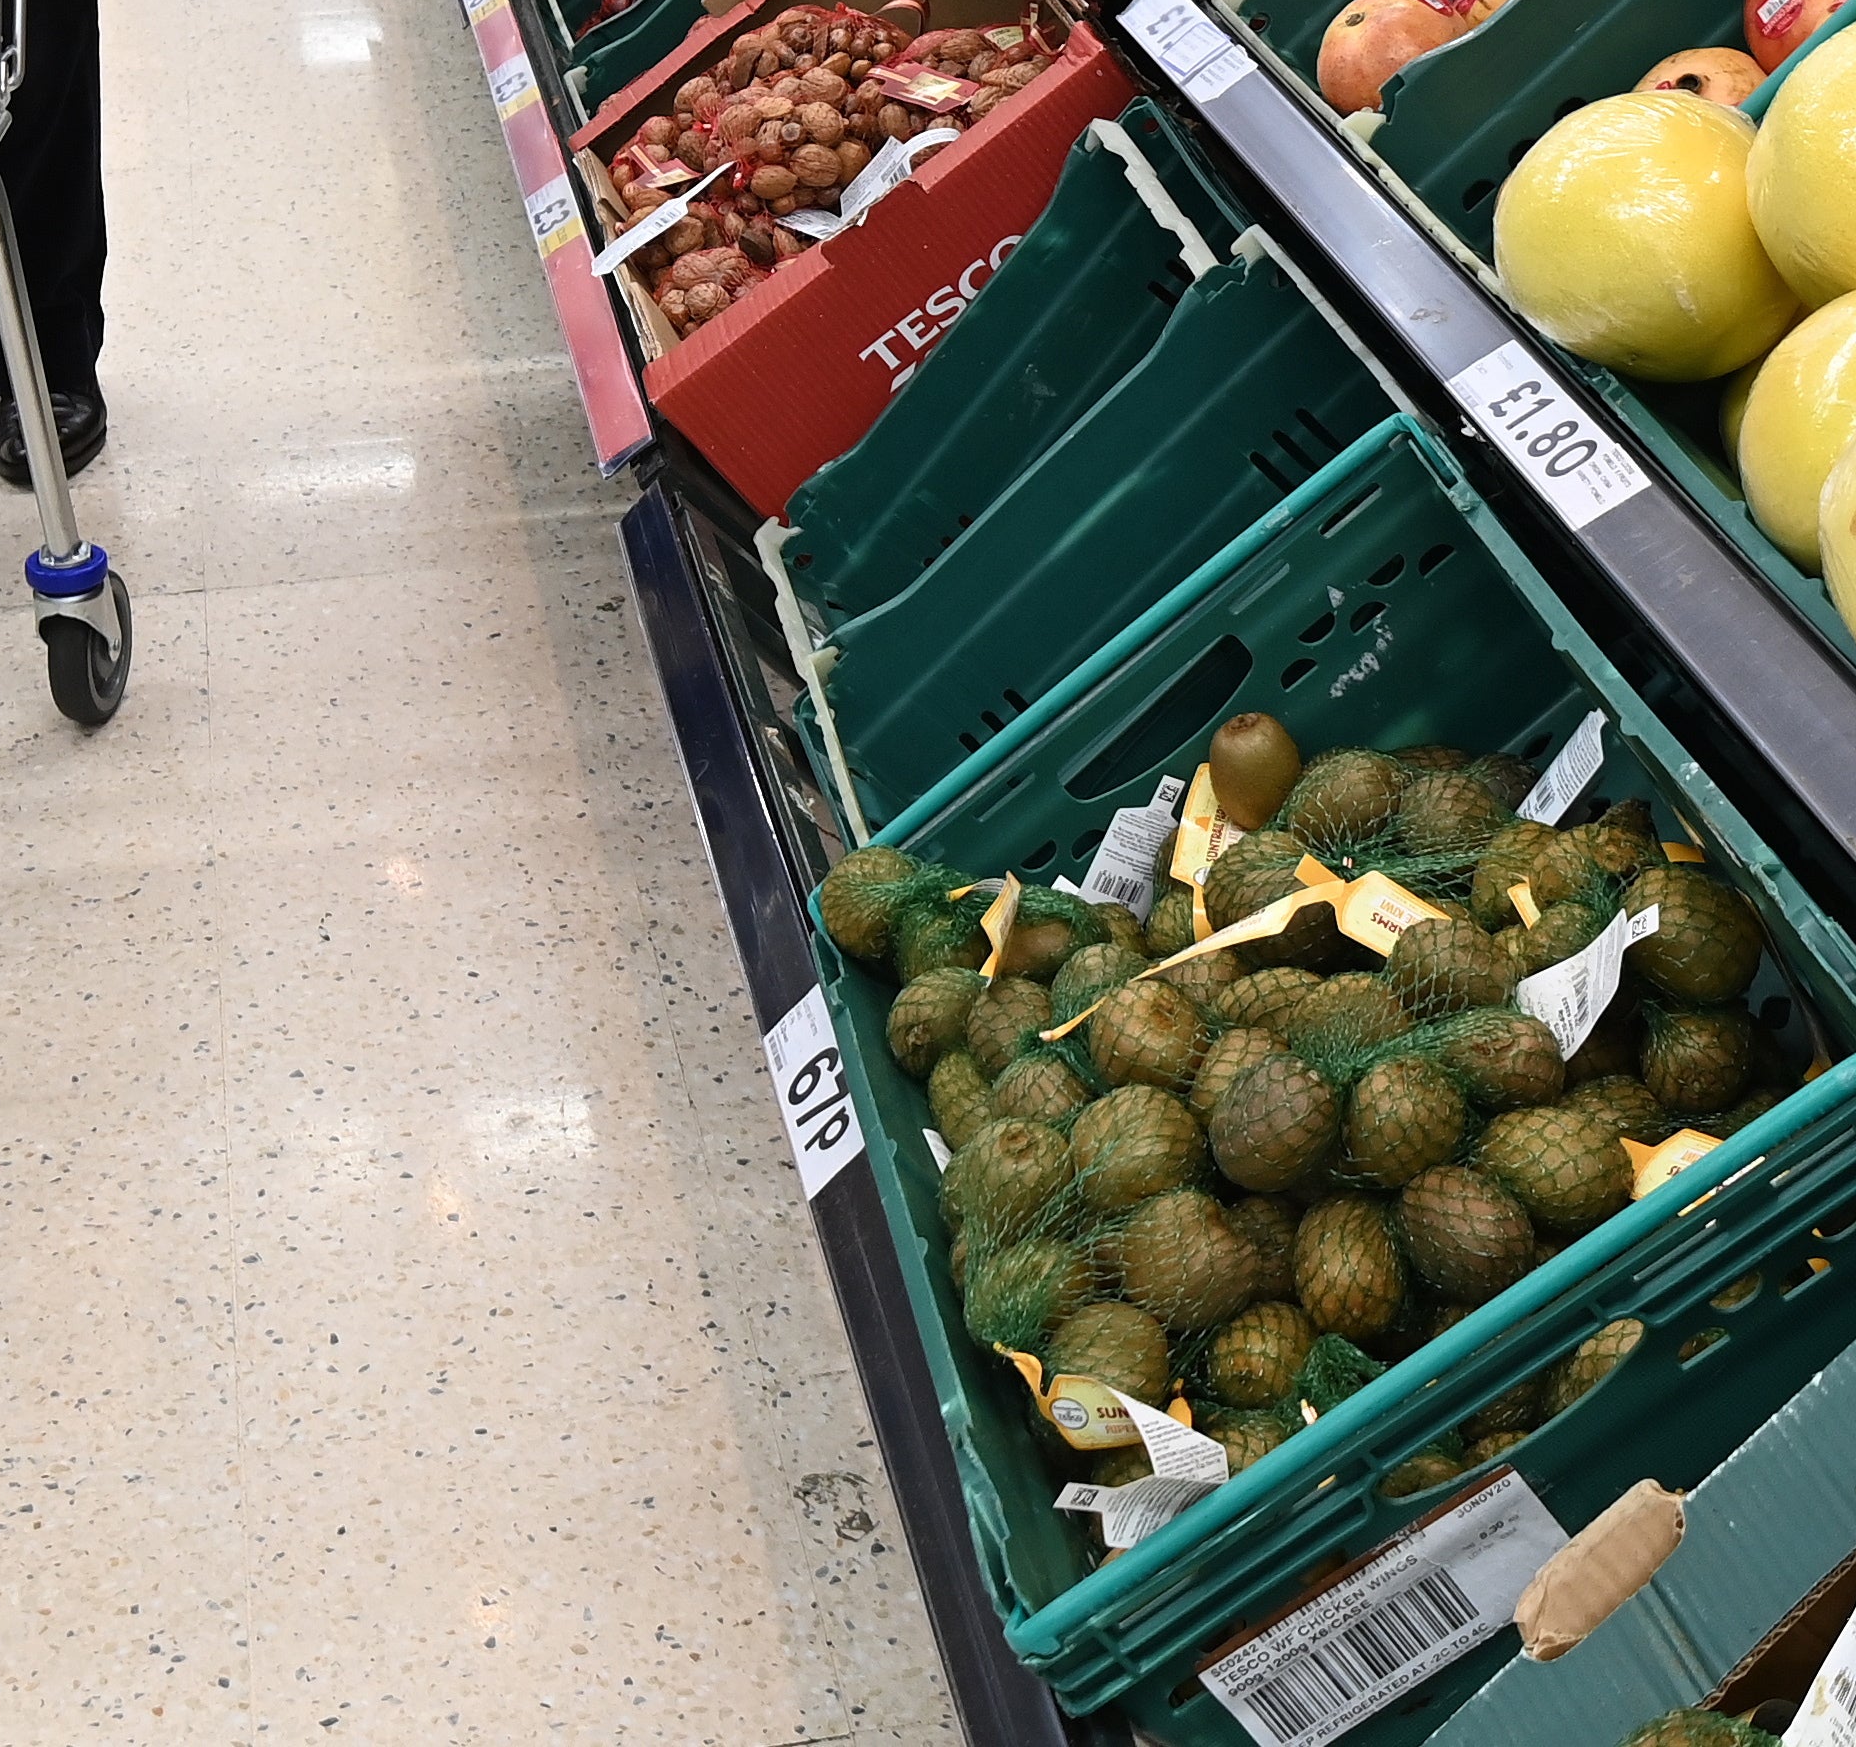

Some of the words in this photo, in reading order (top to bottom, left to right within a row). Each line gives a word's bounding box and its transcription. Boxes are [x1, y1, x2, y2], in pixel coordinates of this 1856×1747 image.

[494, 71, 528, 103] £3
[533, 198, 570, 236] £3
[859, 233, 1023, 370] TESCO
[1487, 380, 1598, 478] £1.80
[1377, 897, 1406, 918] KIWI
[788, 1047, 850, 1152] 67p
[1452, 1478, 1513, 1519] 30NOV20
[1218, 1647, 1271, 1687] TESCO
[1271, 1632, 1296, 1655] WF
[1296, 1587, 1366, 1637] CHICKEN
[1366, 1554, 1419, 1591] WINGS
[1210, 1642, 1260, 1680] SC0242
[1227, 1642, 1310, 1697] 900g-1200g
[1314, 1680, 1403, 1741] REFRIGERATED
[1400, 1662, 1428, 1689] AT
[1427, 1647, 1451, 1669] -2C
[1449, 1634, 1471, 1657] TO
[1469, 1622, 1490, 1644] 4C
